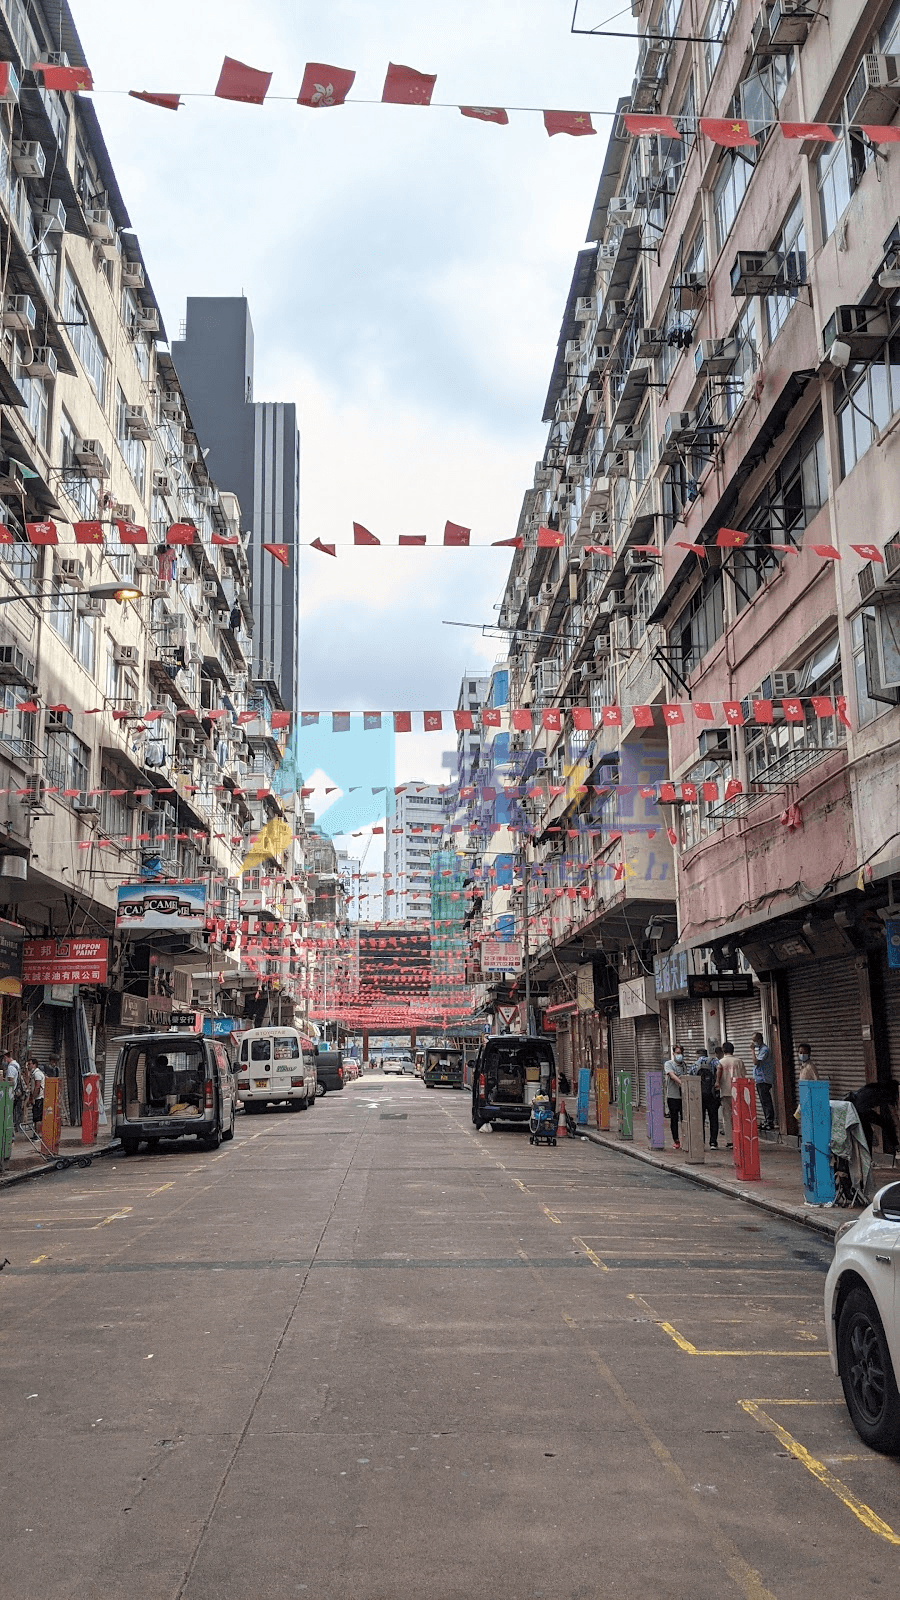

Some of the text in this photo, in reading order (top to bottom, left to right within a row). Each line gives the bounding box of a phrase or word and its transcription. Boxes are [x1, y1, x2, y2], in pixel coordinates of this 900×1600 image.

[150, 900, 178, 909] CAMEL
[23, 945, 52, 957] 立邦
[72, 943, 101, 951] NIPPON
